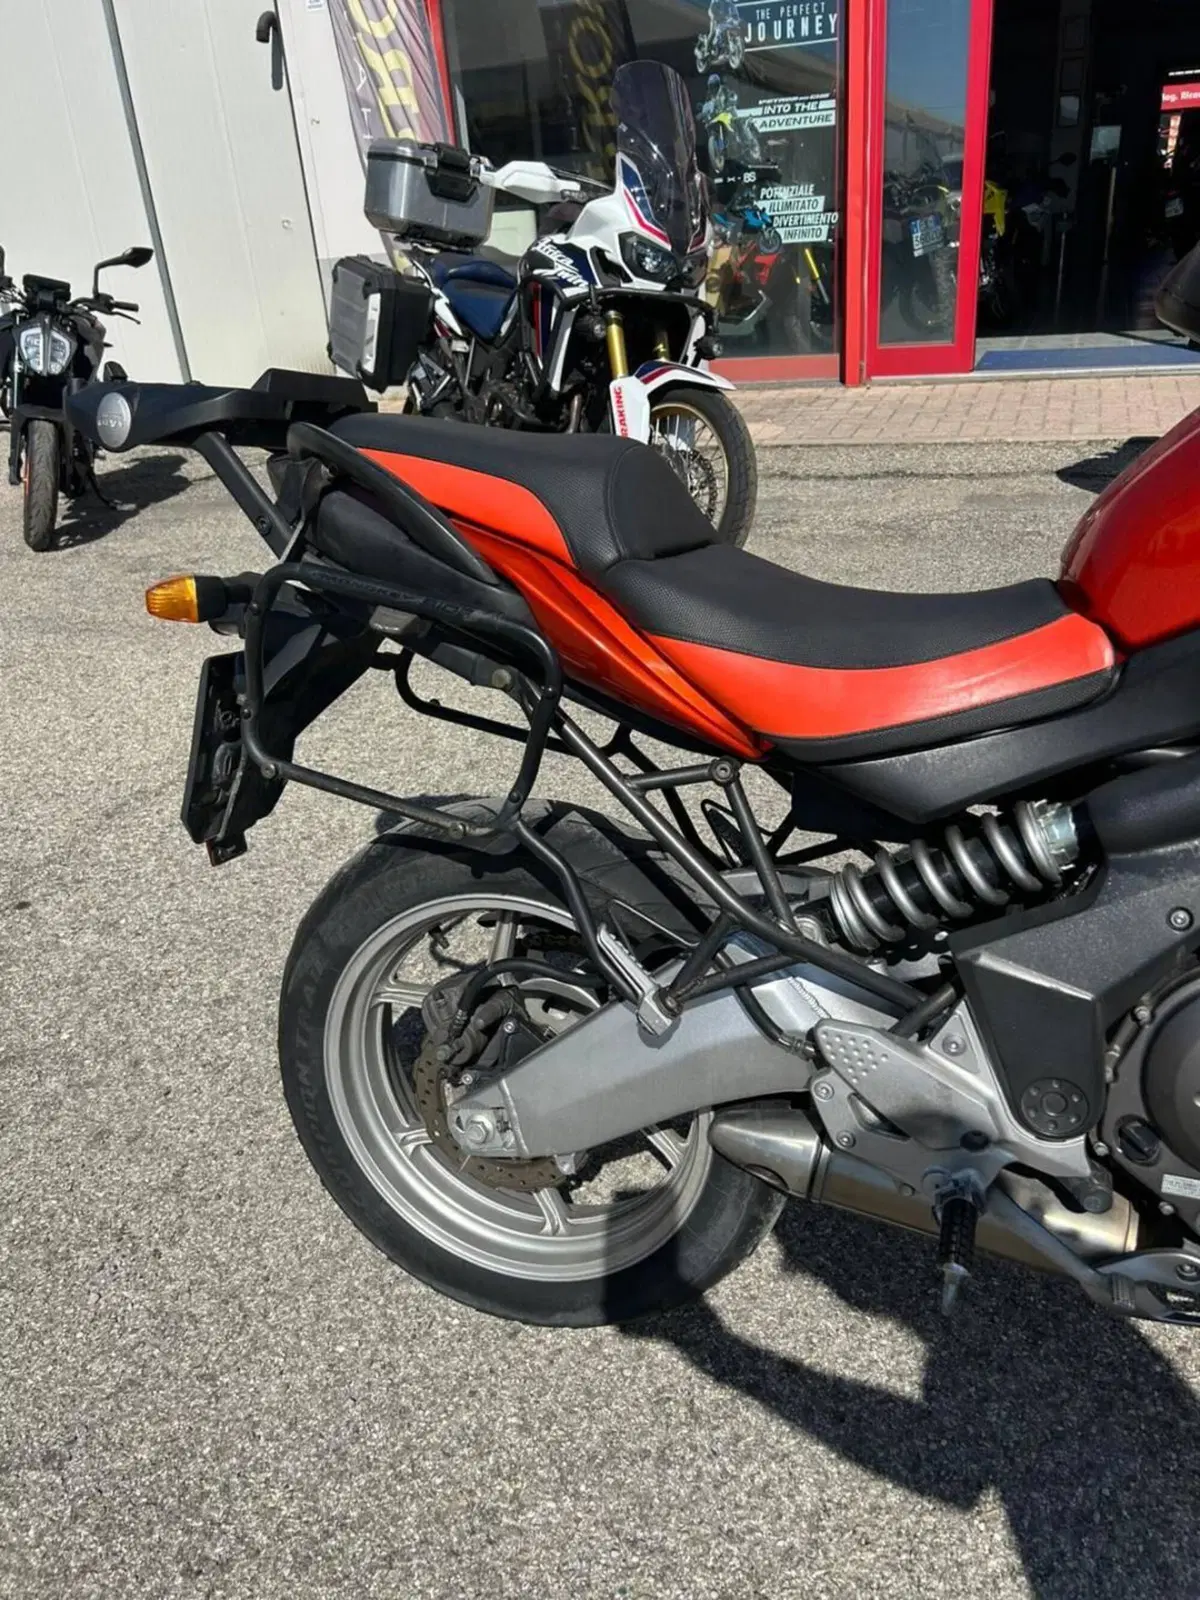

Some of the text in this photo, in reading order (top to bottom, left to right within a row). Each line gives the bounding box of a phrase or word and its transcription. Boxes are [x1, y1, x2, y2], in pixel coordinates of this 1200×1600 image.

[756, 1, 825, 20] THE PERFECT
[744, 13, 838, 43] JOURNEY
[763, 100, 819, 115] INTO THE
[759, 113, 832, 128] ADVENTURE
[760, 184, 815, 199] POTENZIALE
[768, 199, 819, 213] ILLIMITATO
[772, 211, 839, 227] DIVERTIMENTO
[783, 227, 823, 240] INFINITO
[613, 385, 628, 438] RAKING
